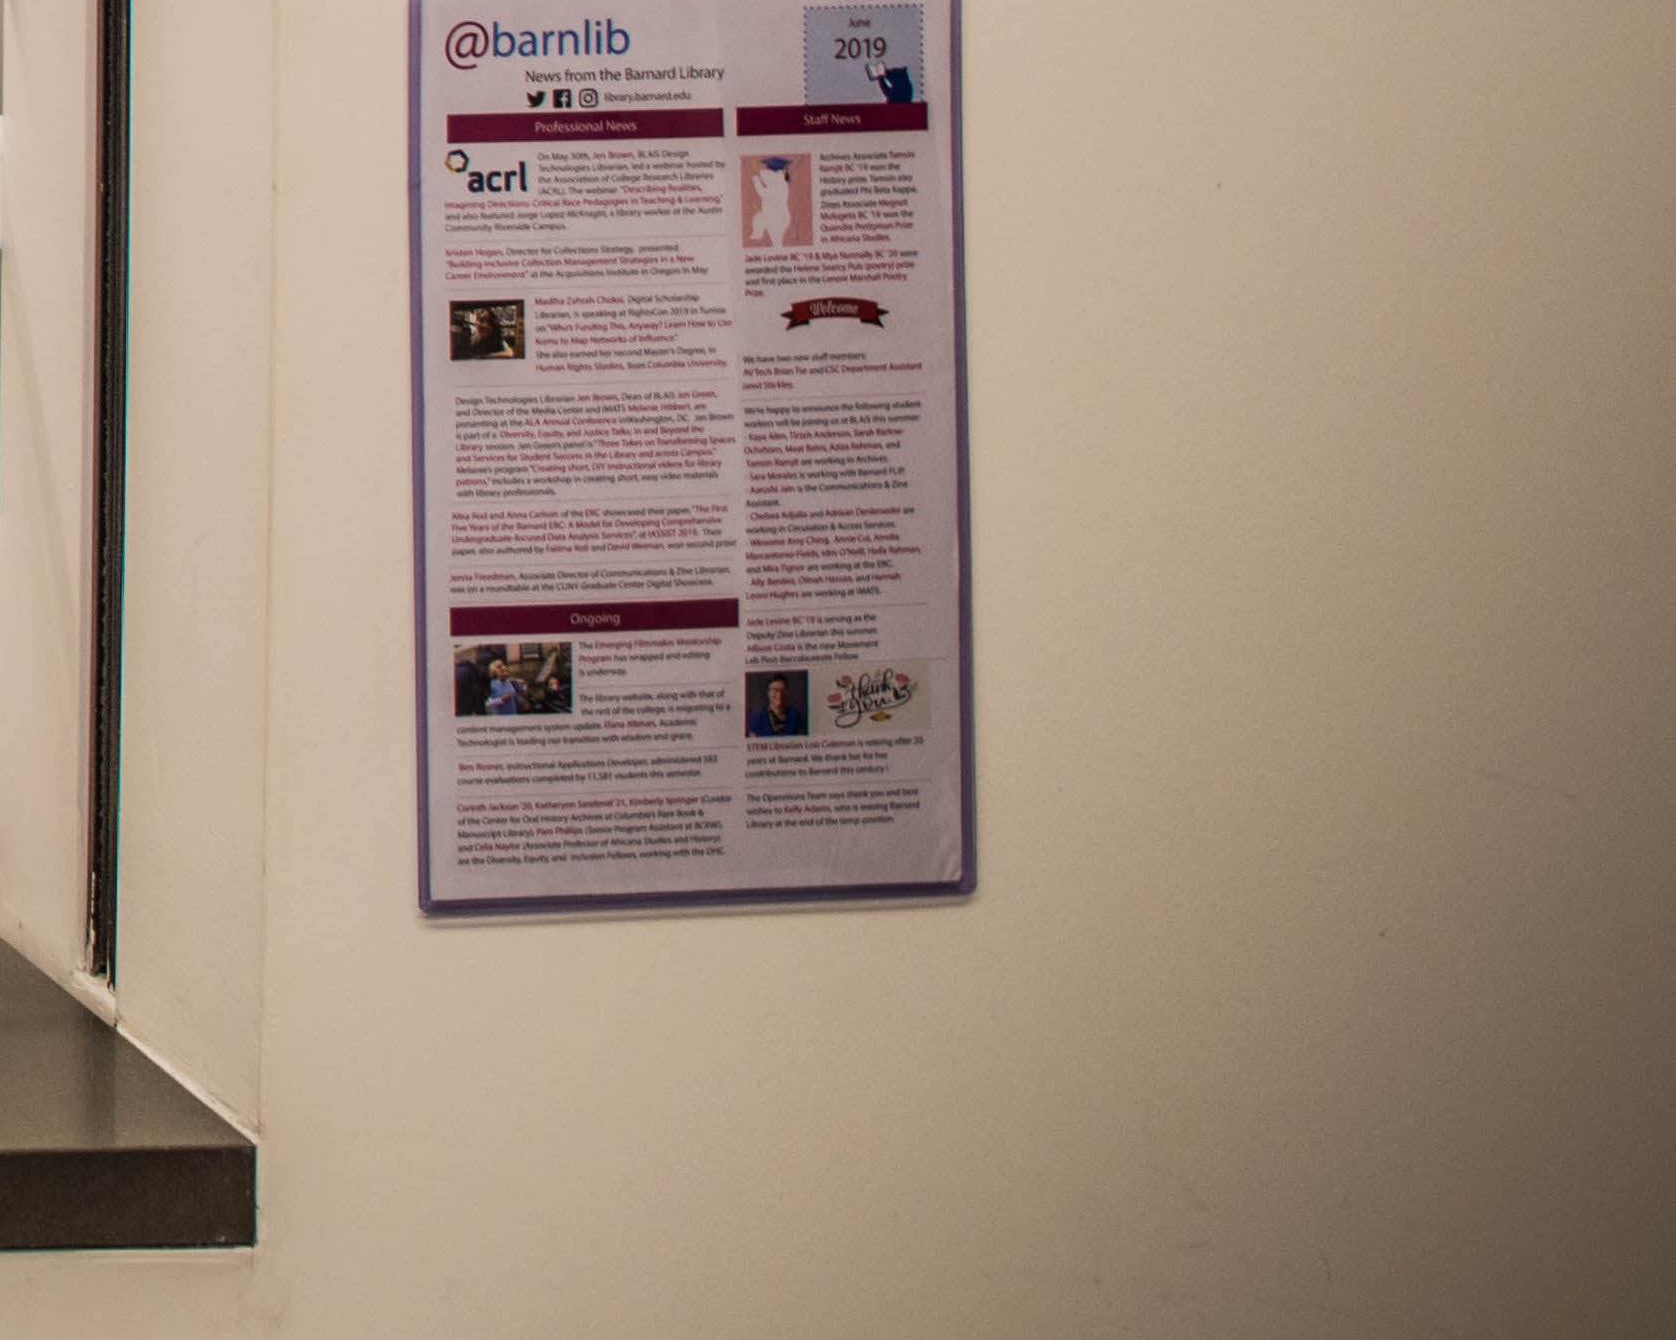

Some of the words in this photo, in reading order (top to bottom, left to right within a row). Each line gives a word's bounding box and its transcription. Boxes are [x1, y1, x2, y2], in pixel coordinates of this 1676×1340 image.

[848, 18, 871, 29] June
[445, 19, 630, 70] @barnlib
[834, 37, 887, 59] 2019
[526, 71, 561, 84] News
[564, 70, 596, 82] from
[600, 69, 621, 82] the
[625, 68, 675, 81] Barnard
[679, 66, 724, 81] Library
[604, 91, 691, 103] library.barnard.edu
[534, 121, 604, 133] Professional
[606, 120, 637, 132] News
[804, 114, 829, 125] Staff
[831, 114, 861, 125] News
[468, 161, 527, 192] acrl
[809, 302, 859, 316] Welcome
[570, 613, 621, 627] Ongoing
